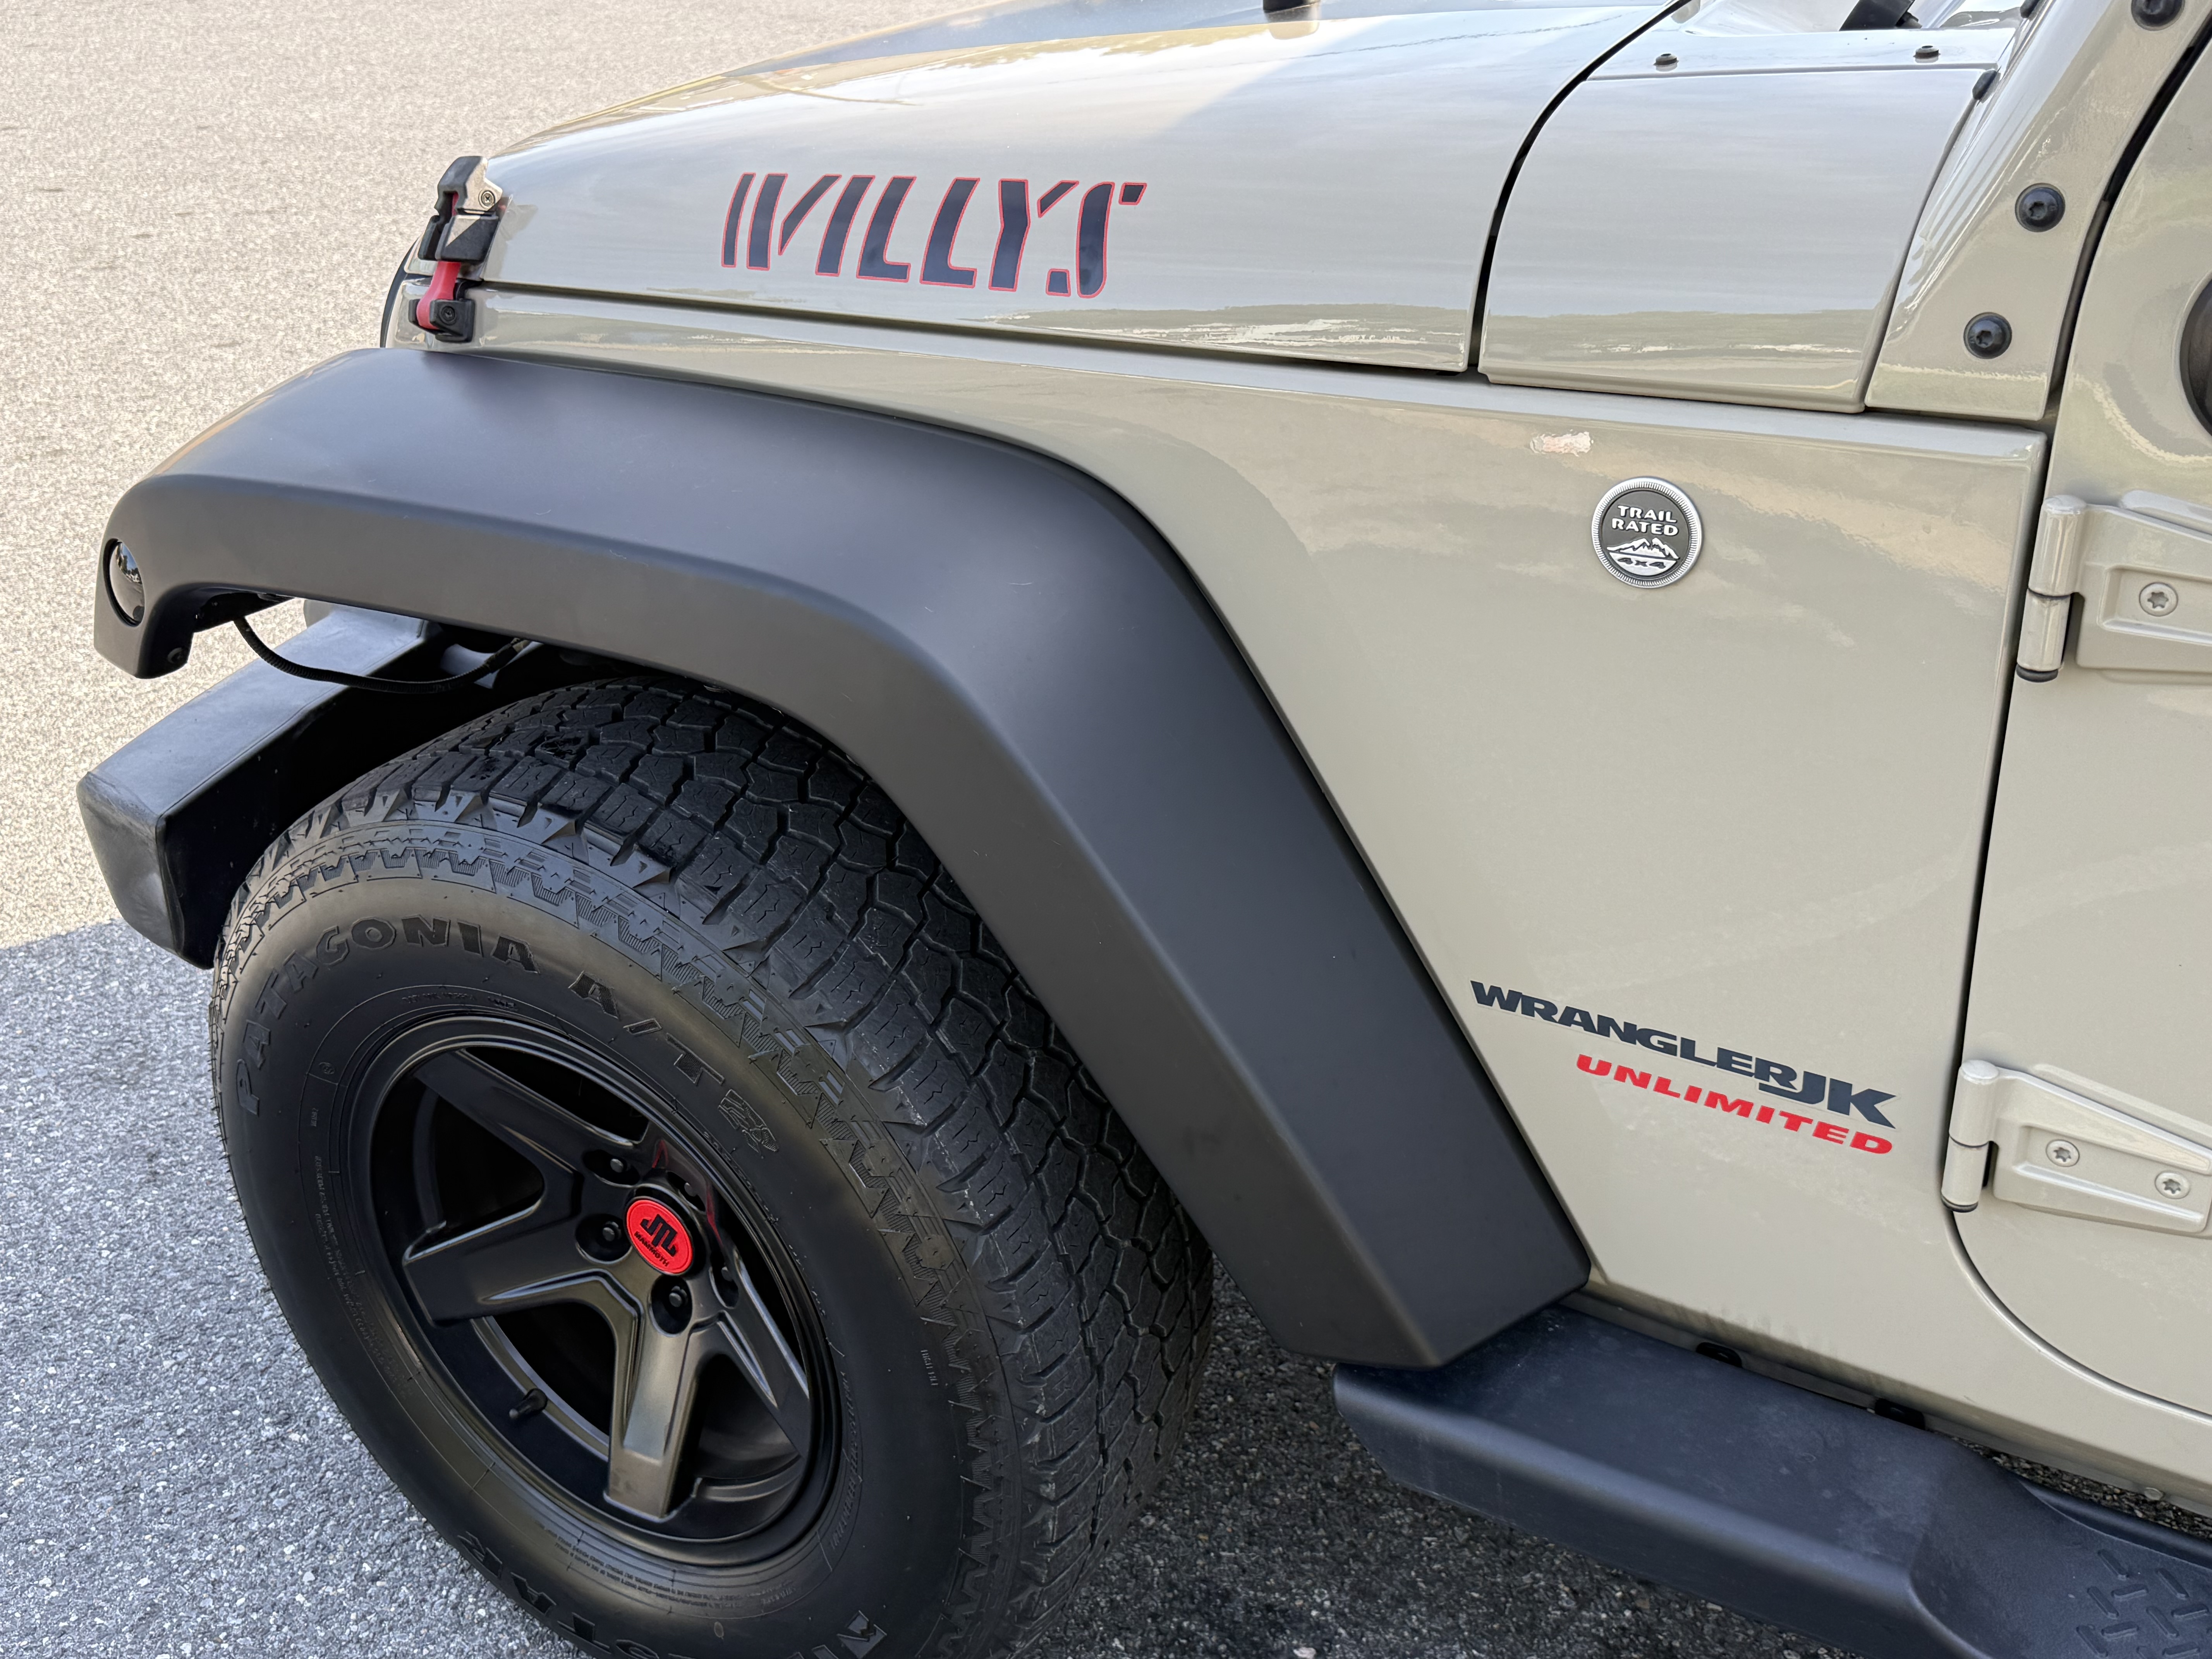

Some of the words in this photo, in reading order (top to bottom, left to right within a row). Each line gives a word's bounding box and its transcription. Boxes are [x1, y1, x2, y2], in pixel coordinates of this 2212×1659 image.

[721, 172, 1148, 299] WILLYS
[1611, 518, 1679, 536] RATED
[1618, 505, 1677, 523] TRAIL
[236, 914, 540, 1117] PATAGONIA
[1576, 1053, 1893, 1155] UNLIMITED
[634, 1231, 670, 1267] MAMMOTH
